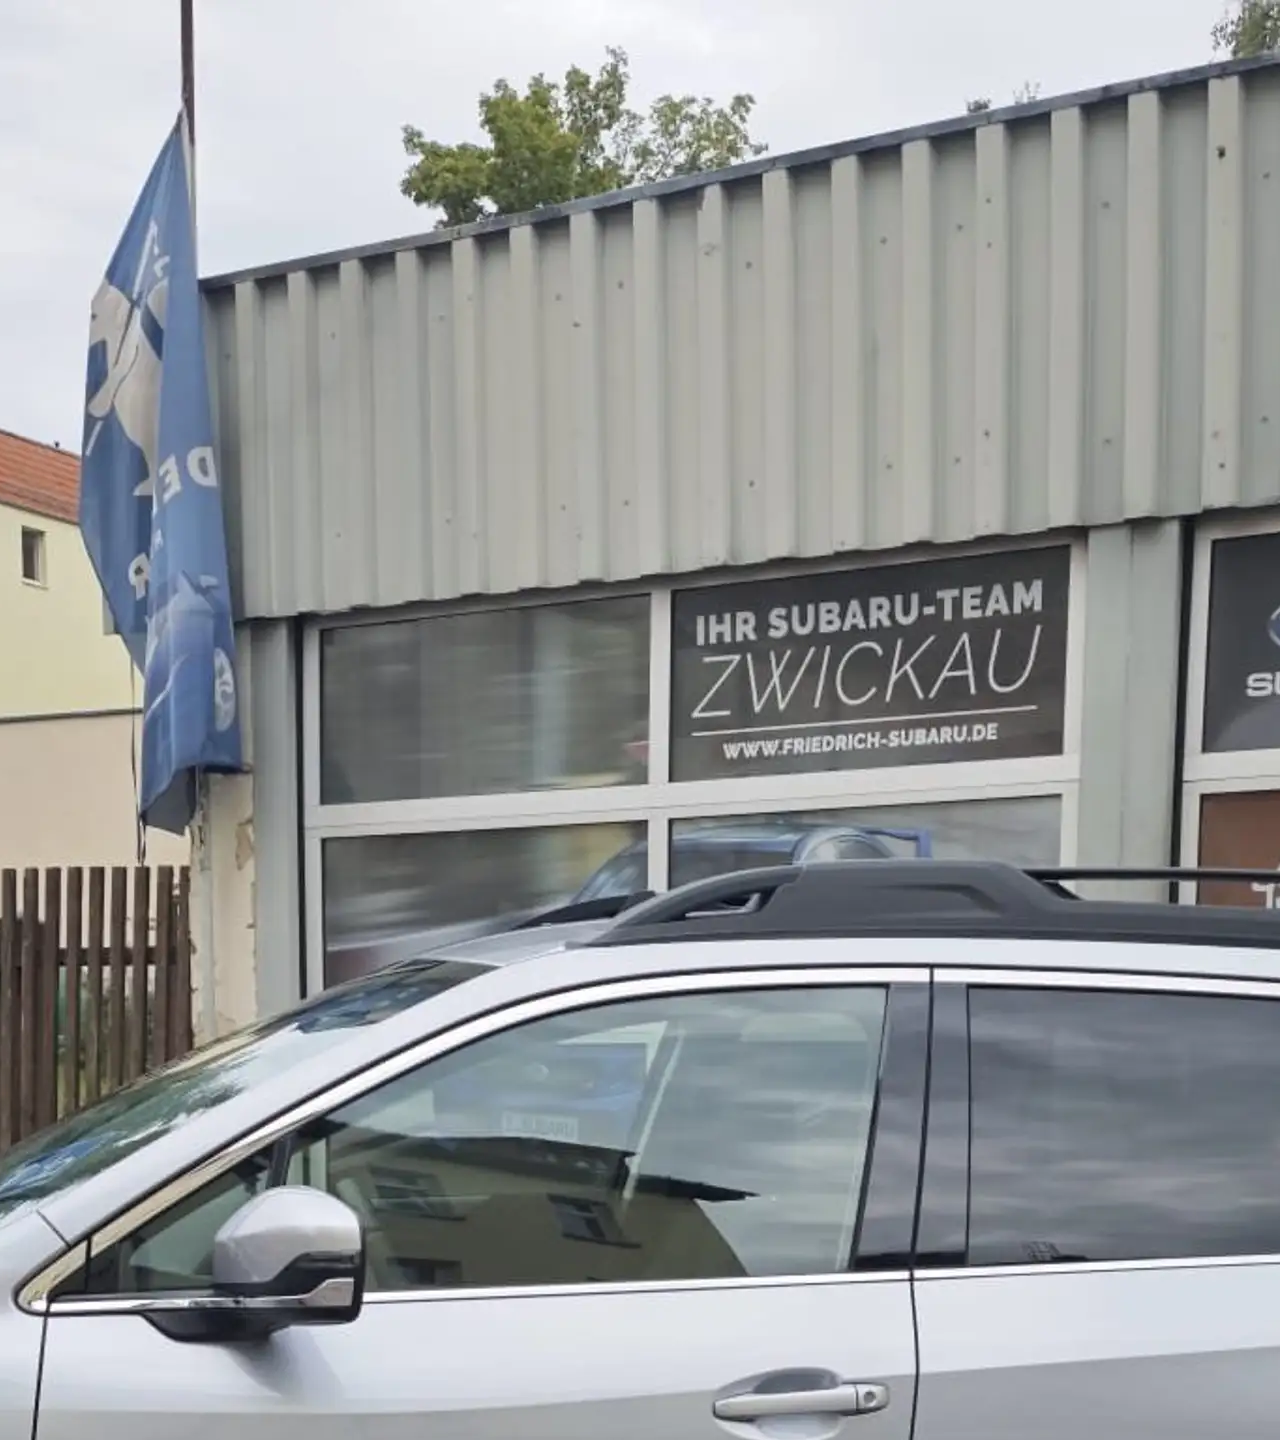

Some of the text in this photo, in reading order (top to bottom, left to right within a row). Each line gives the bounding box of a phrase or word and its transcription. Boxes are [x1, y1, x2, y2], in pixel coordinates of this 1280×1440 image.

[696, 579, 1043, 646] IHR SUBARU-TEAM
[691, 624, 1044, 719] ZWICKAU
[723, 723, 998, 760] WWW.FRIEDRICH-SUBARU.DE
